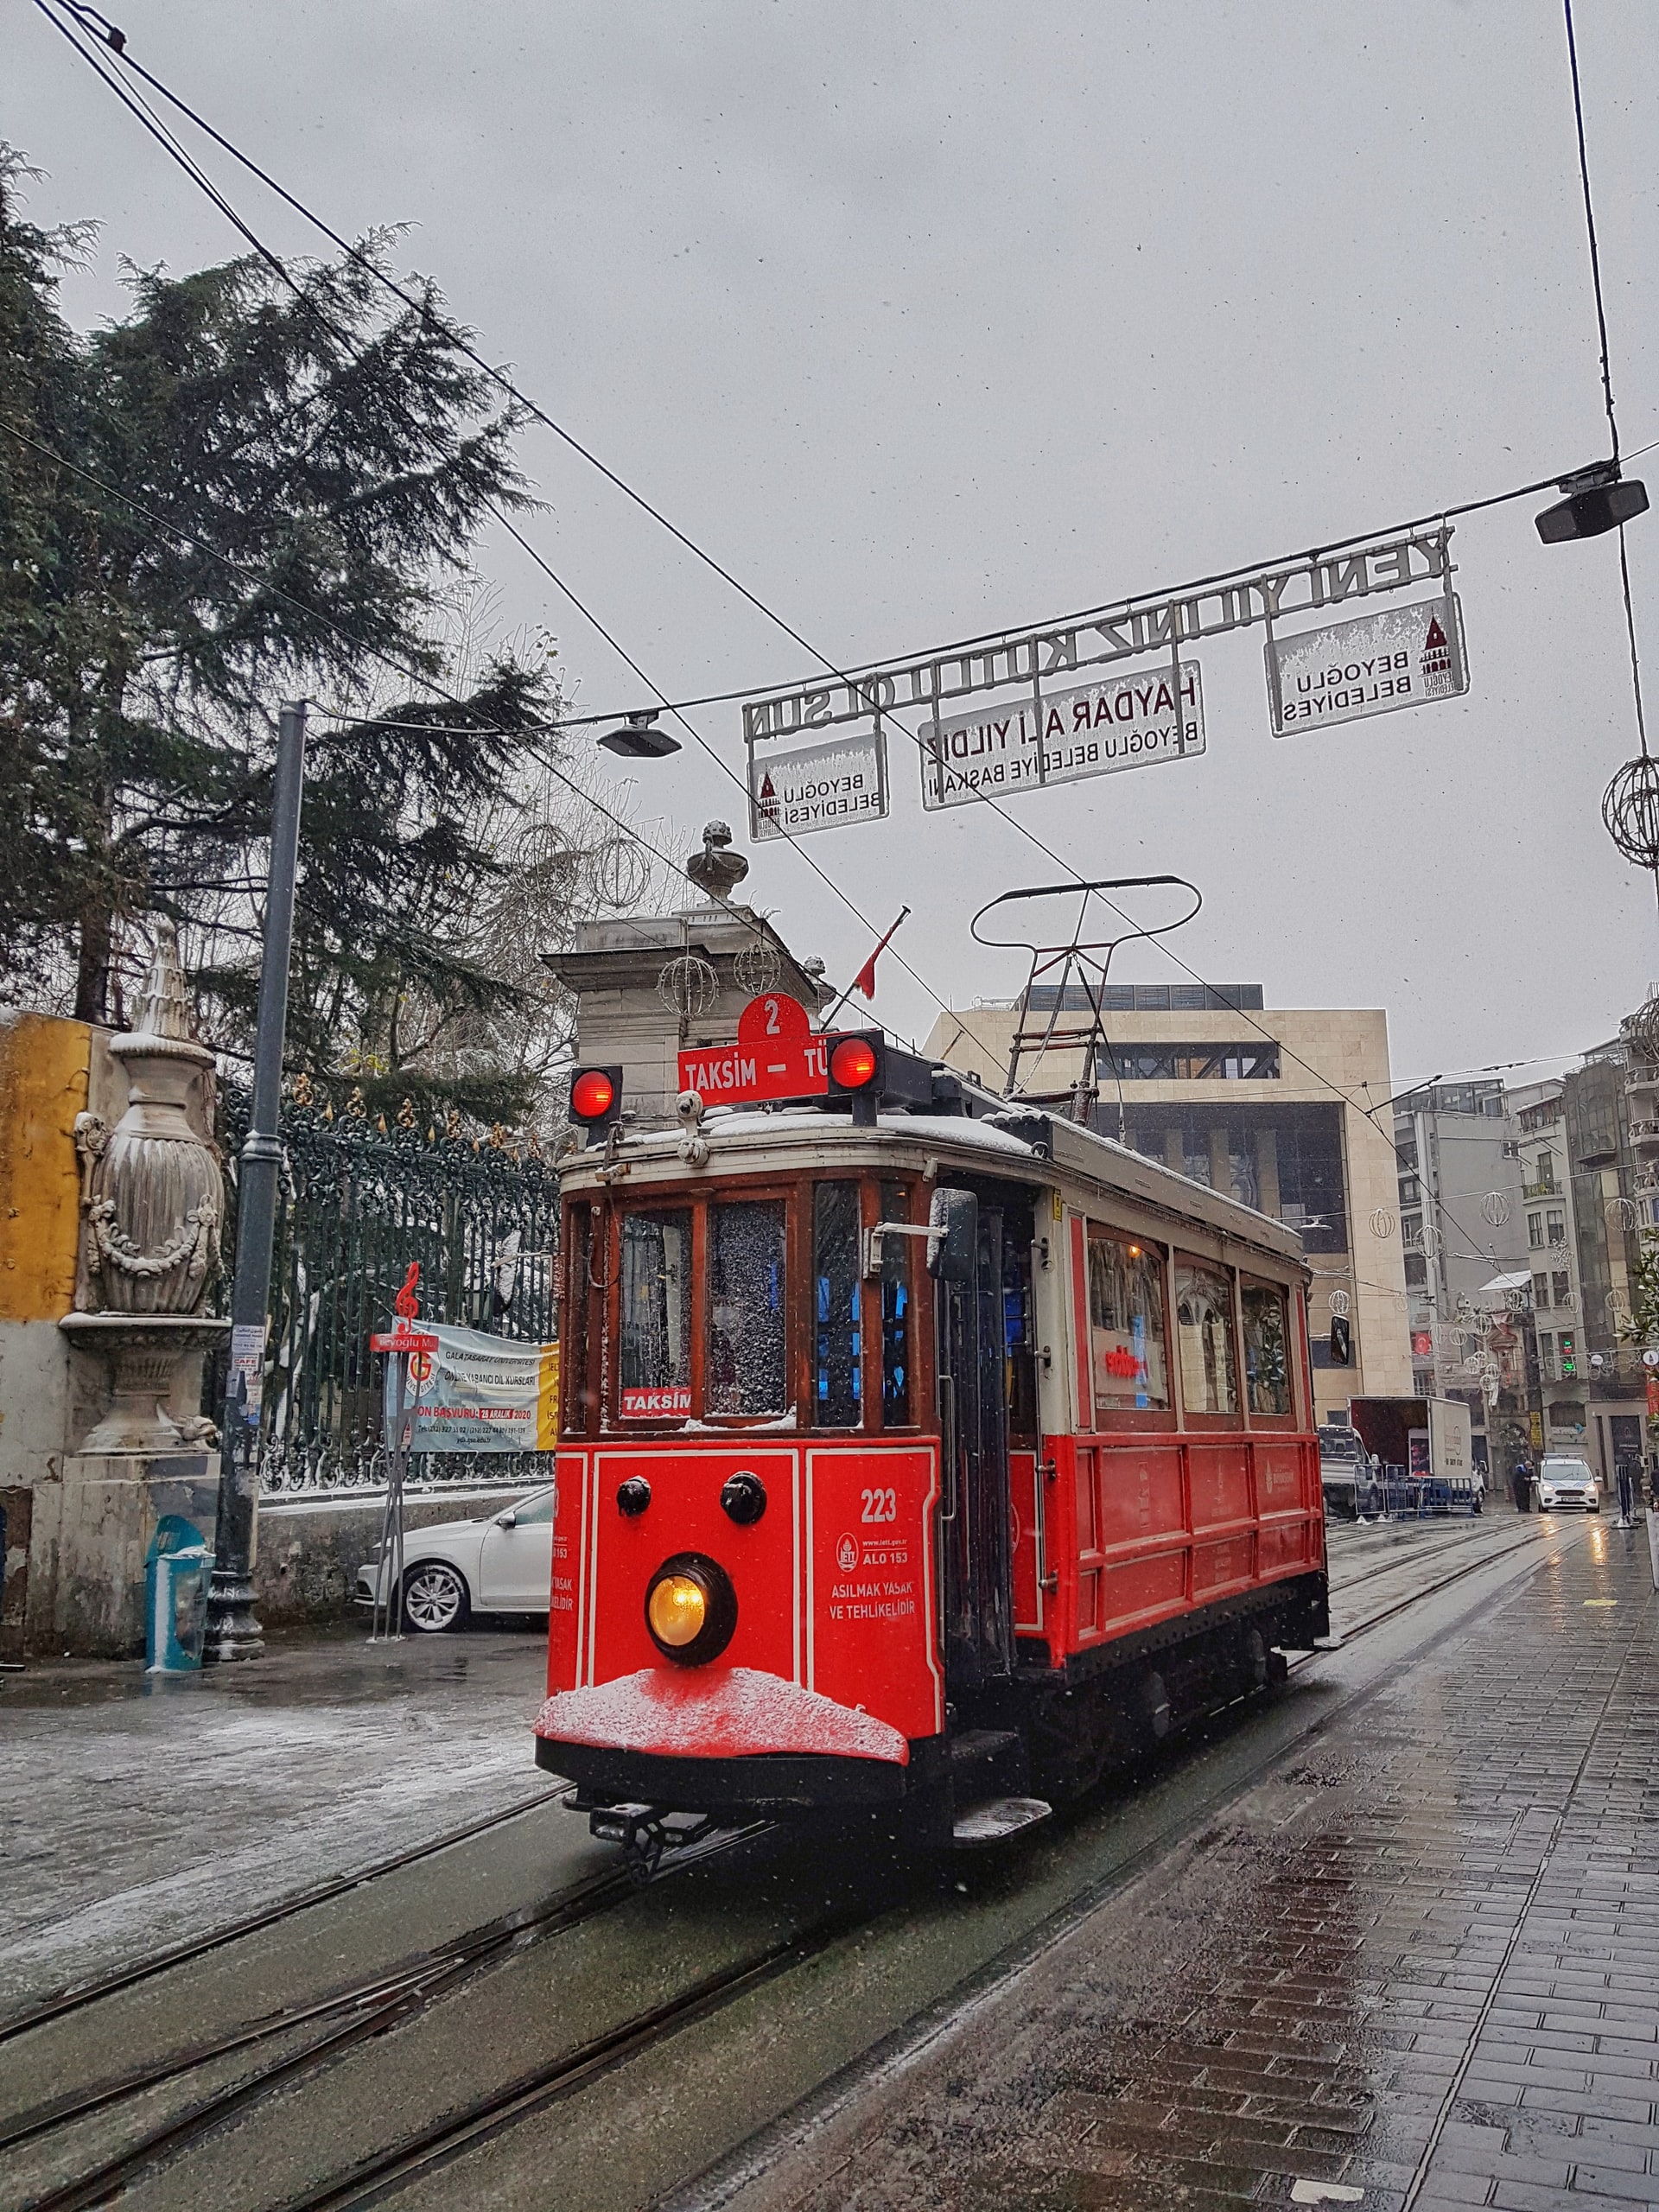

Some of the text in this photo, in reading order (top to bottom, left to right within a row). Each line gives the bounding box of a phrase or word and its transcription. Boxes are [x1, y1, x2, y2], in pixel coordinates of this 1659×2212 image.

[764, 999, 780, 1035] 2
[685, 1051, 756, 1091] TAKSİM
[379, 1335, 419, 1348] Beyoğlu
[624, 1391, 691, 1410] TAKSİM
[417, 1406, 432, 1417] ON
[490, 1409, 511, 1419] ARALIK
[514, 1410, 531, 1420] 2020
[861, 1488, 896, 1523] 223
[862, 1552, 907, 1565] ALO 153
[831, 1582, 912, 1599] ASILMAK YASAK
[830, 1599, 915, 1619] VE TEHLİKELİDİR
